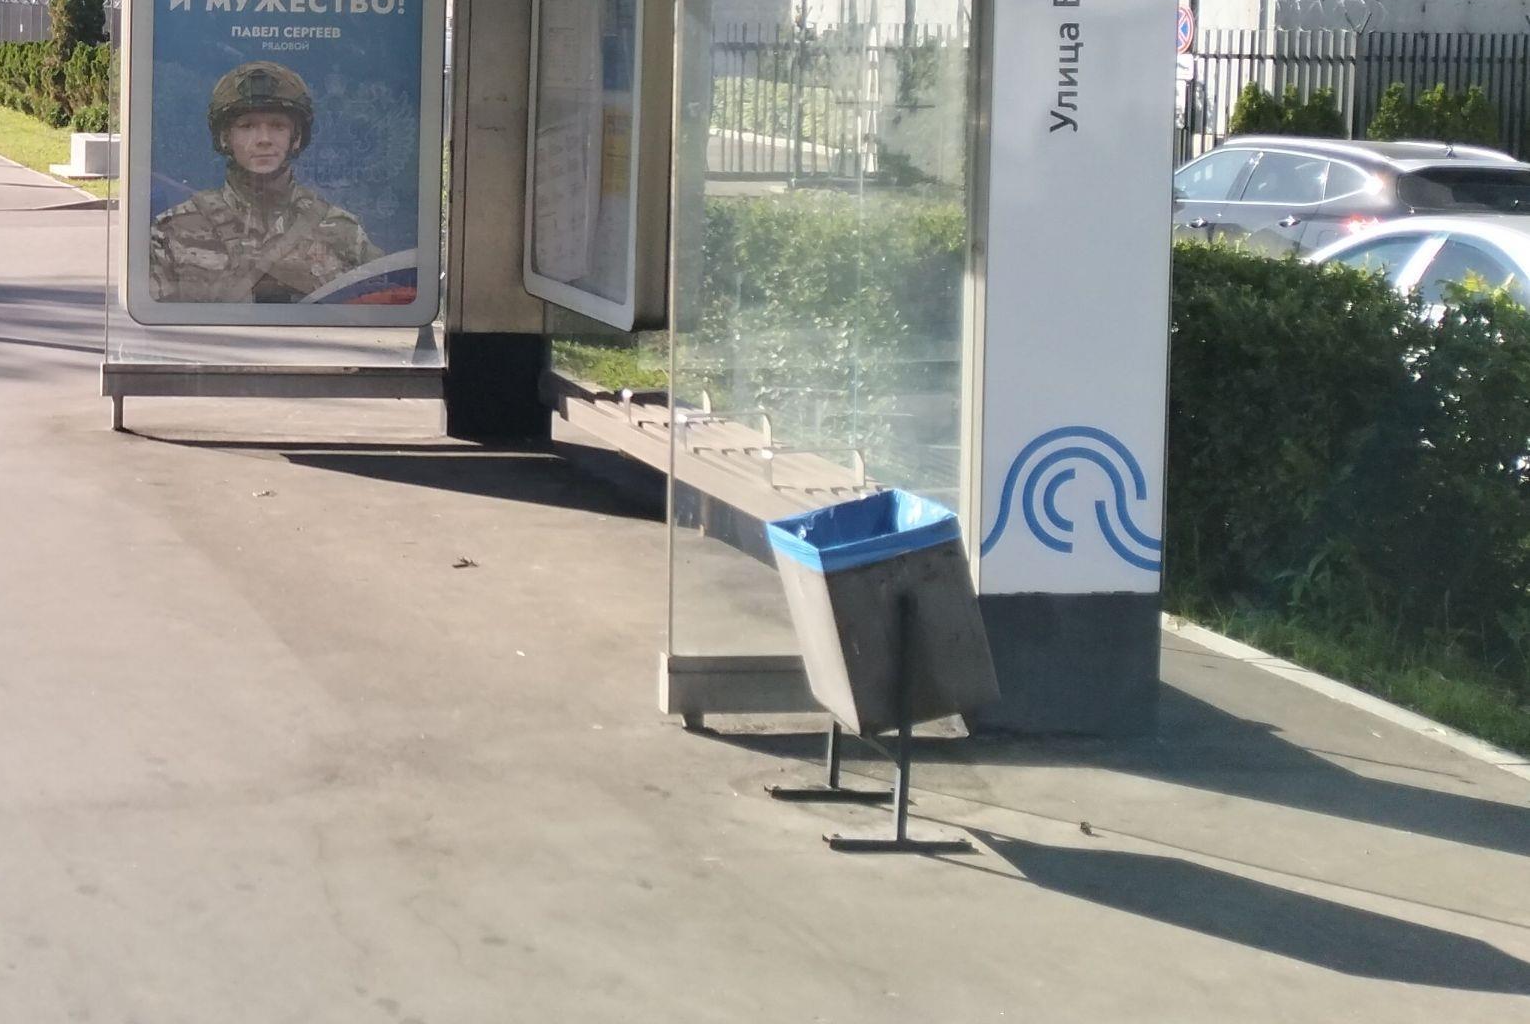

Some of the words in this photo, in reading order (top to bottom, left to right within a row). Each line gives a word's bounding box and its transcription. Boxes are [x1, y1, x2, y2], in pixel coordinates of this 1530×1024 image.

[231, 26, 279, 38] ПАВЕЛ
[283, 26, 341, 39] СЕРГЕЕВ
[261, 40, 310, 51] РЯДОВОЙ
[1049, 22, 1084, 133] Улица
